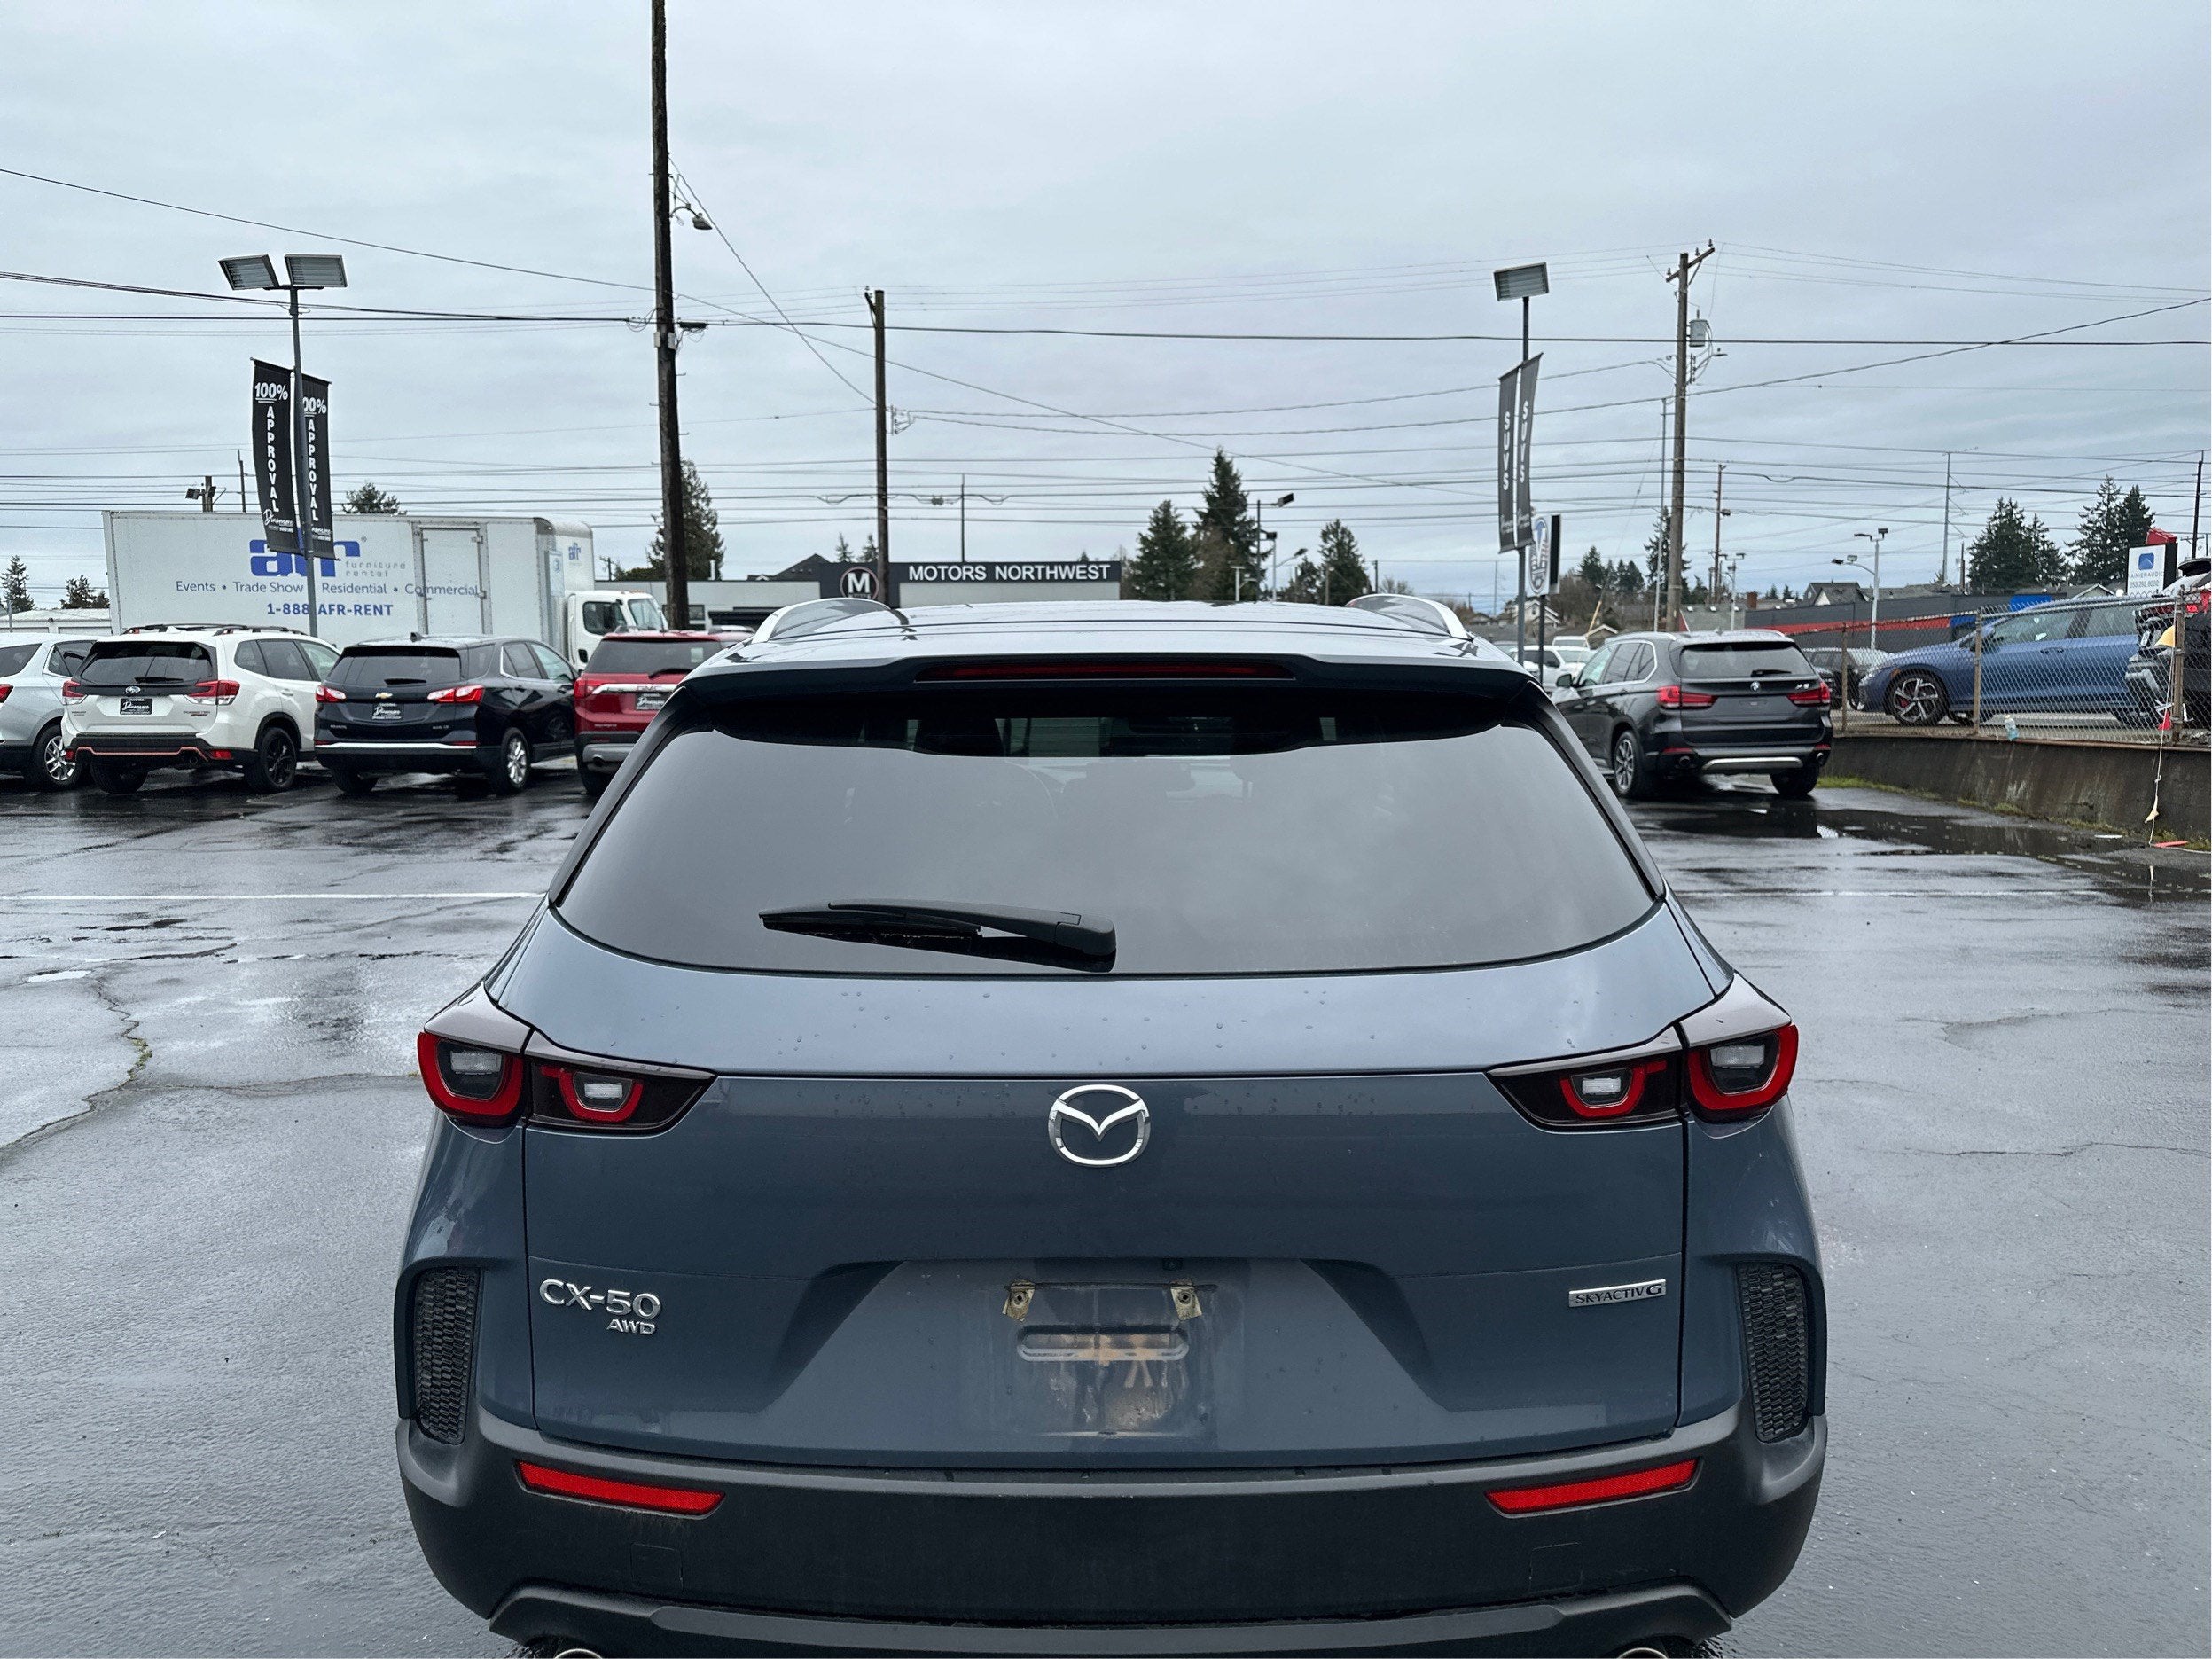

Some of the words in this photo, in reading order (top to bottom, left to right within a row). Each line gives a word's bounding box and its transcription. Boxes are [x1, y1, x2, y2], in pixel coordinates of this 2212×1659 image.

[254, 382, 289, 401] 100%
[302, 396, 327, 415] 00%
[266, 405, 279, 513] APPROVAL
[308, 419, 319, 522] APPROVAL
[345, 560, 406, 570] furniture
[909, 565, 987, 581] MOTORS
[995, 564, 1111, 580] NORTHWEST
[176, 581, 215, 592] Events
[232, 581, 266, 593] Trade
[270, 582, 304, 593] Show
[322, 583, 387, 594] Residential
[404, 583, 479, 596] Commercial
[847, 572, 871, 594] M
[267, 603, 394, 616] 1-888AFR-RENT
[539, 1279, 661, 1319] CX-50
[606, 1318, 656, 1335] AWD
